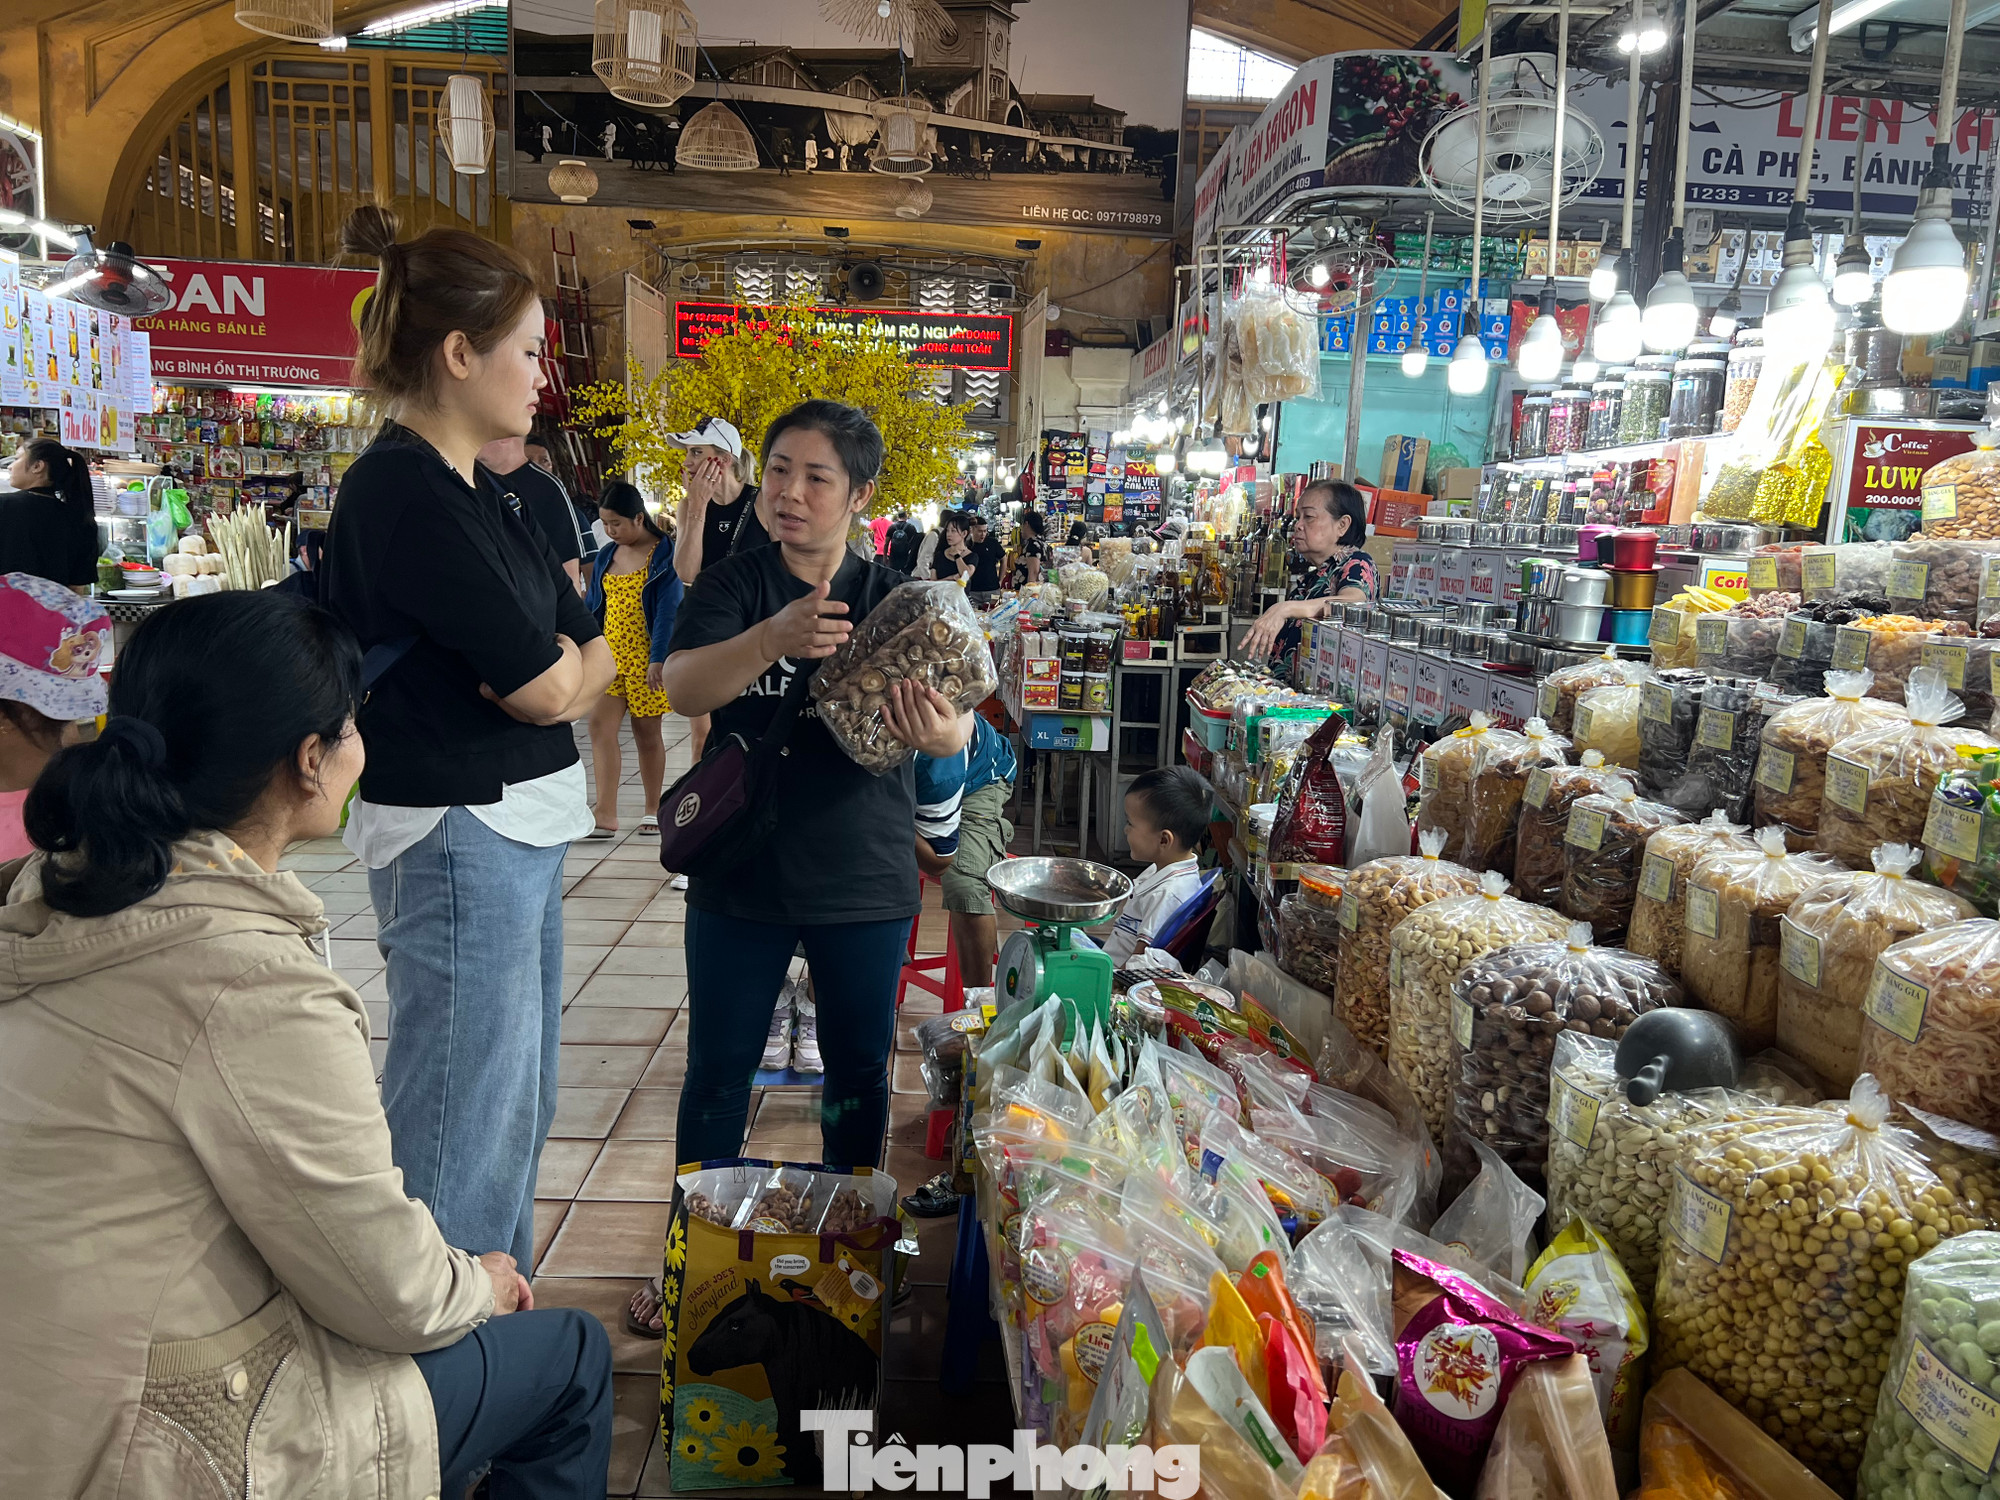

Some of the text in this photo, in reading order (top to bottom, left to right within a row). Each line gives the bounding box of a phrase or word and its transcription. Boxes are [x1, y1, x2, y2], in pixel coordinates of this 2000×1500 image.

[1242, 130, 1263, 187] LIÊN
[1264, 79, 1318, 163] SAIGON
[1702, 143, 1744, 176] CÀ
[1295, 176, 1311, 190] 409
[1691, 186, 1741, 201] 1233
[1023, 204, 1162, 225] LIÊN HỆ QC: 0971798979
[136, 315, 267, 336] CỬA HÀNG BÁN LẺ
[899, 322, 920, 339] RÕ
[966, 329, 1001, 341] DOANH
[950, 342, 963, 354] AN
[965, 341, 993, 355] TOÀN
[1144, 337, 1168, 379] HELLO
[178, 358, 211, 375] BÌNH
[214, 358, 236, 376] ỔN
[237, 364, 260, 380] THỊ
[262, 362, 320, 380] TRƯỜNG
[1883, 433, 1930, 453] Coffee
[1470, 575, 1493, 594] WEASEL
[1036, 731, 1050, 740] XL
[687, 1266, 736, 1304] TRADER JOE'S
[688, 1276, 740, 1331] Maryland
[1088, 1333, 1110, 1350] Liên
[1423, 1368, 1480, 1407] WAN MEI
[1935, 1368, 1968, 1400] BẢNG
[1970, 1394, 1997, 1419] GIÁ
